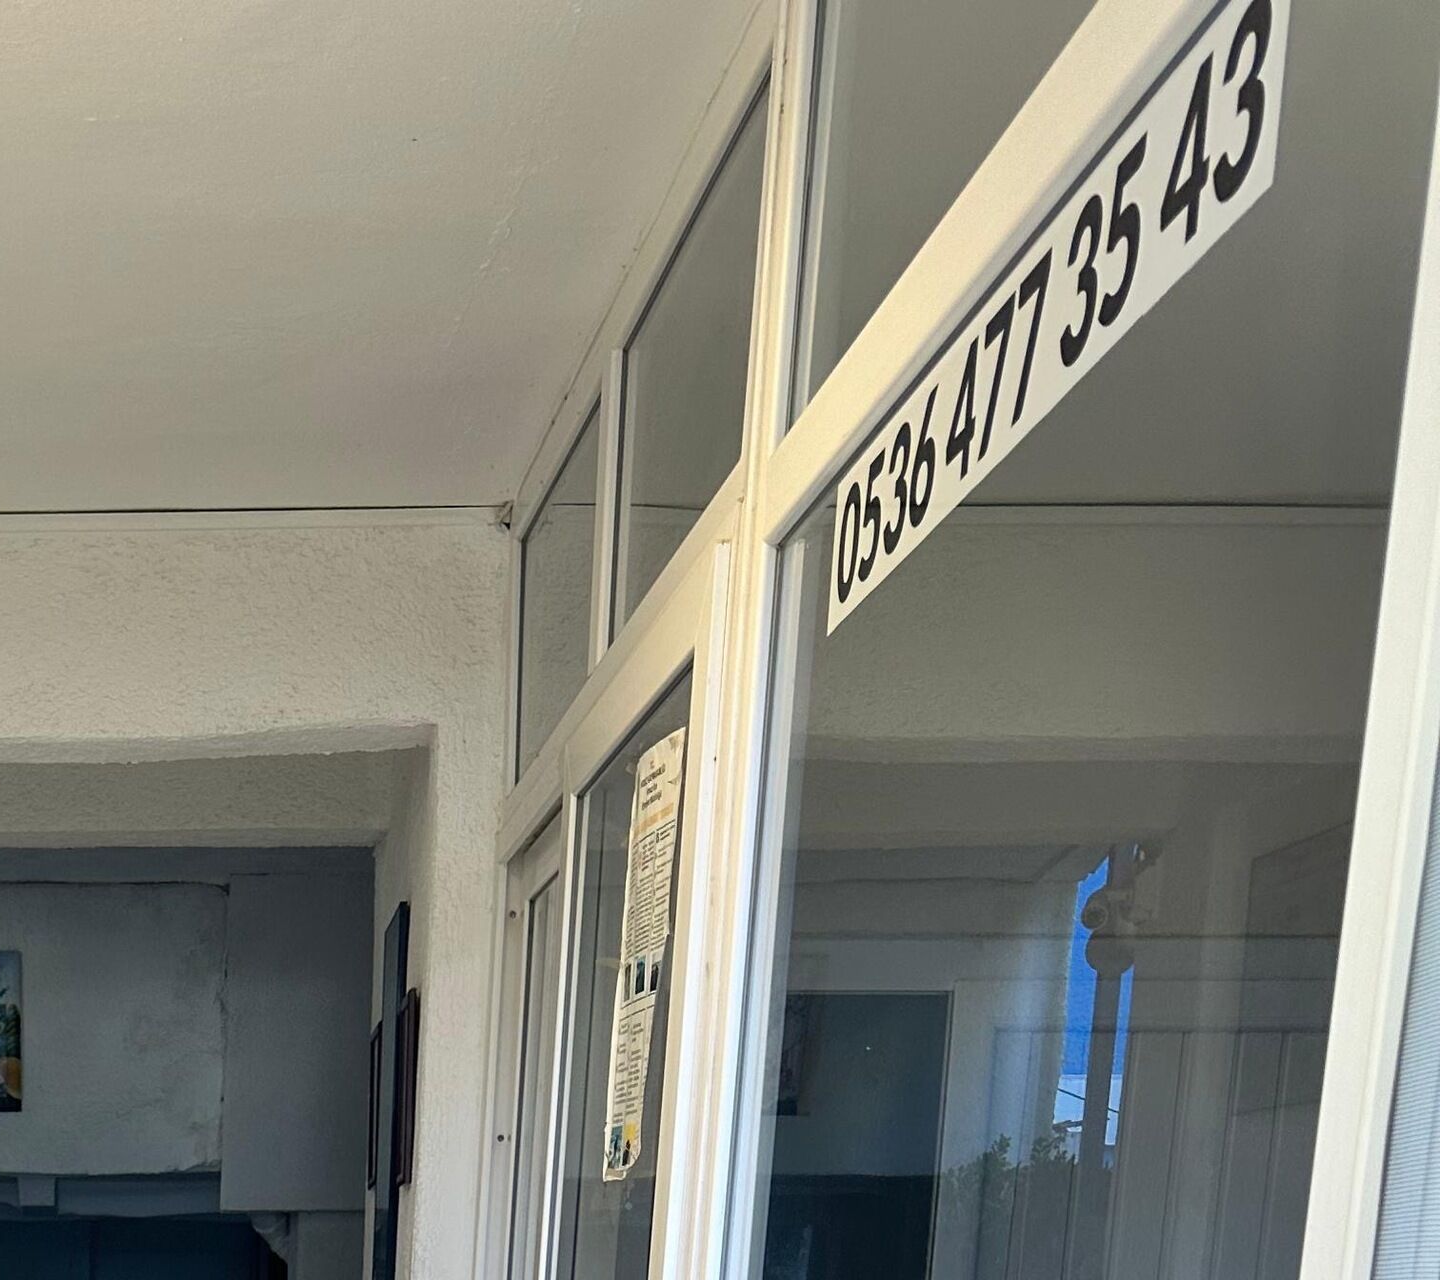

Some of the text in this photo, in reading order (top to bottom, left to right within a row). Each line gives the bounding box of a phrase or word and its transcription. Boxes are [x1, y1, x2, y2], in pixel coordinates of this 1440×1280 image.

[837, 0, 1273, 603] 0536 477 35 43
